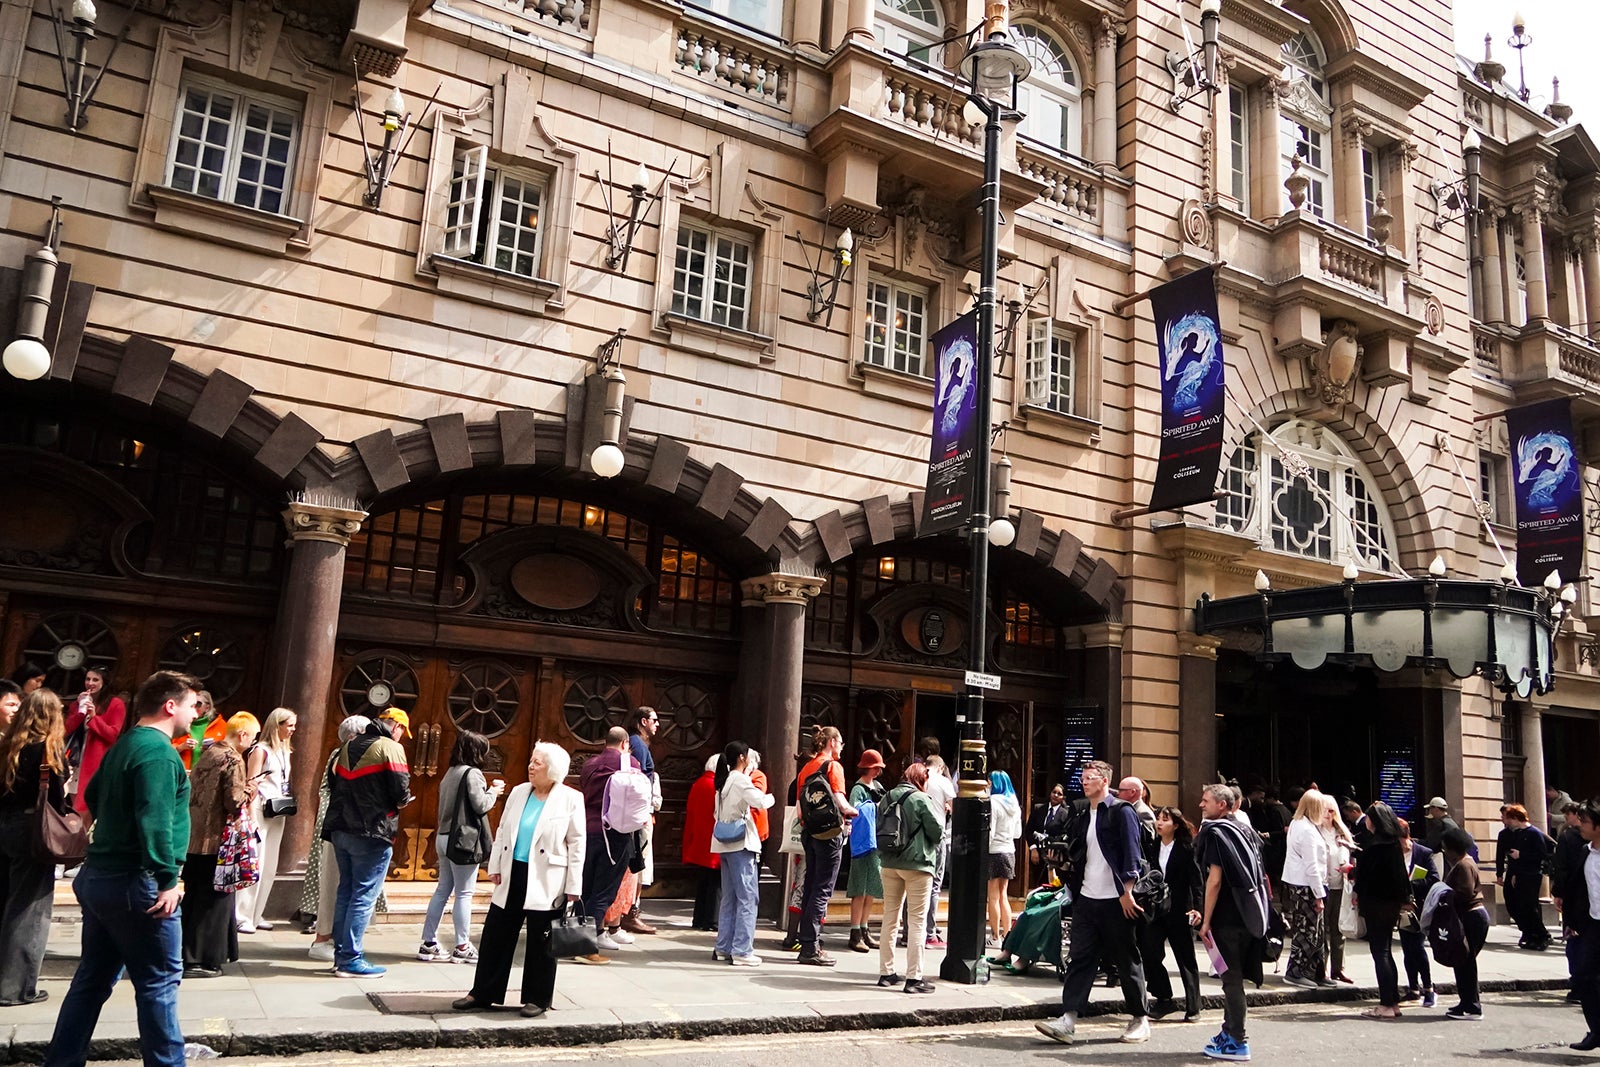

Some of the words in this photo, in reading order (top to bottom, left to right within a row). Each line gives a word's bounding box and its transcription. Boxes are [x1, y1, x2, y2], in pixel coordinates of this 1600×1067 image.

[1163, 422, 1197, 438] SPIRITED
[1198, 413, 1222, 428] AWAY
[930, 457, 955, 473] SPIRITED
[954, 448, 973, 463] AWAY
[1173, 468, 1201, 479] COLISEUM
[930, 506, 945, 515] LONDON
[945, 501, 963, 511] COLISEUM
[1518, 519, 1555, 529] SPIRITED
[1556, 513, 1580, 524] AWAY
[1534, 556, 1563, 564] COLISEUM
